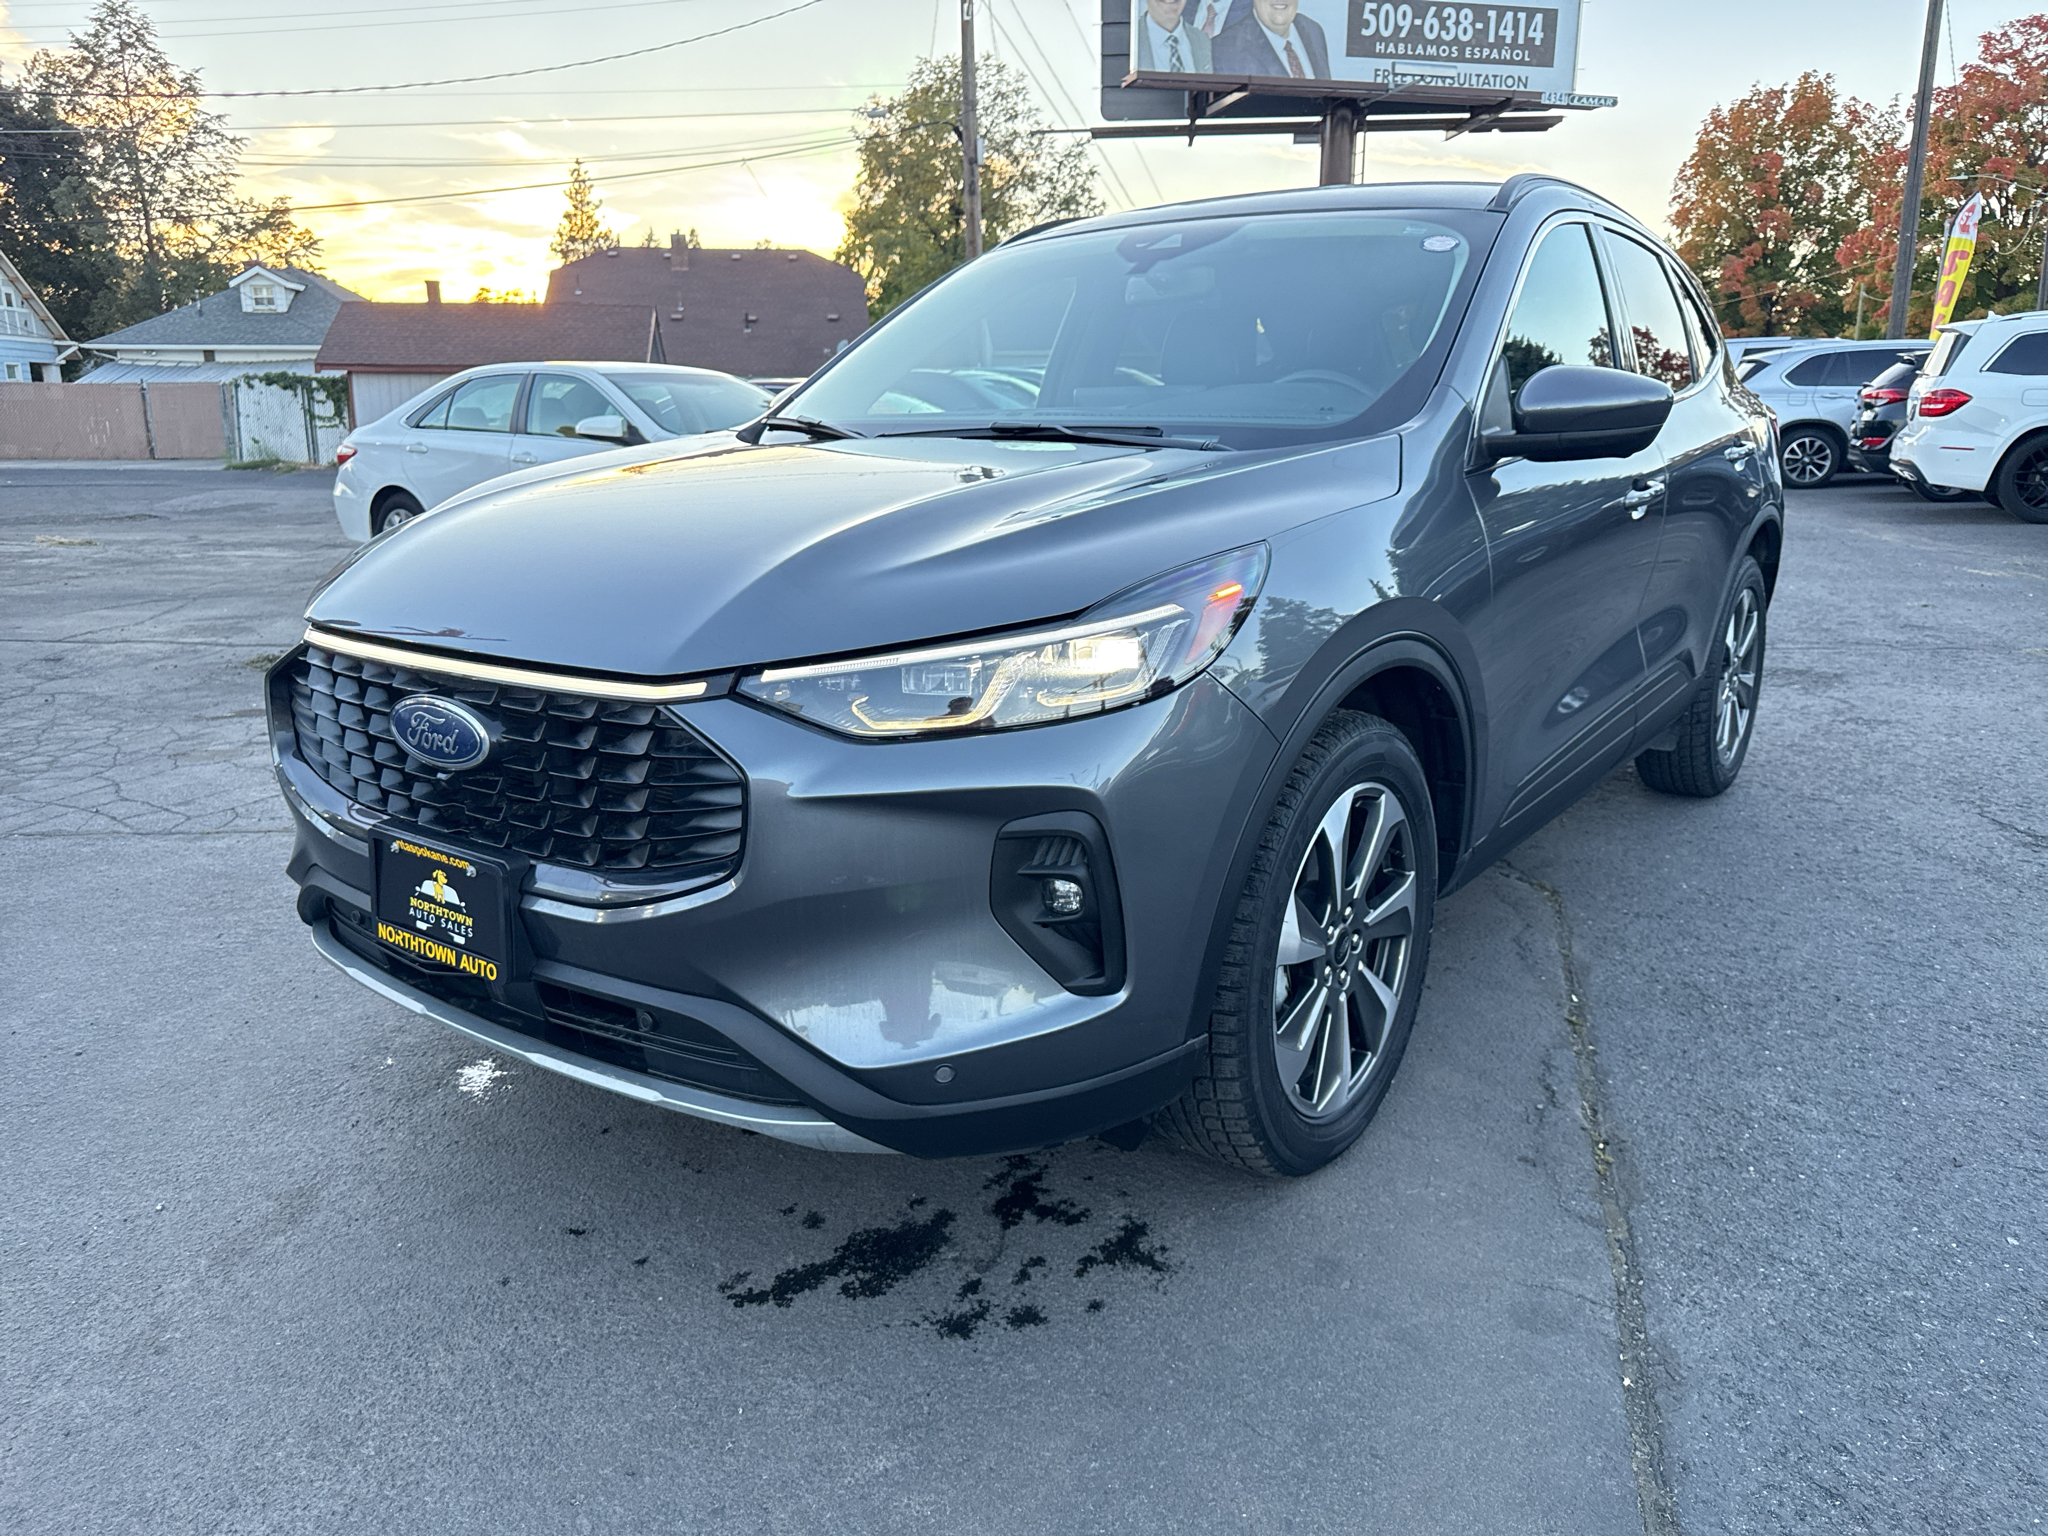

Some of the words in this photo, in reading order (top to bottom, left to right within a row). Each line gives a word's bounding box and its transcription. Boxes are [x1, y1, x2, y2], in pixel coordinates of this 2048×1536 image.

[1361, 2, 1544, 46] 509-638-1414
[1375, 41, 1459, 58] HABLAMOS
[1465, 45, 1531, 62] ESPAÑOL
[1374, 68, 1407, 84] FREE
[1573, 95, 1614, 107] LAMAR
[407, 711, 460, 755] Ford
[408, 907, 436, 924] AUTO
[440, 918, 474, 938] SALES
[409, 896, 474, 927] NORTHTOWN
[378, 922, 456, 967] NORTHTOWN
[460, 957, 497, 981] AUTO
